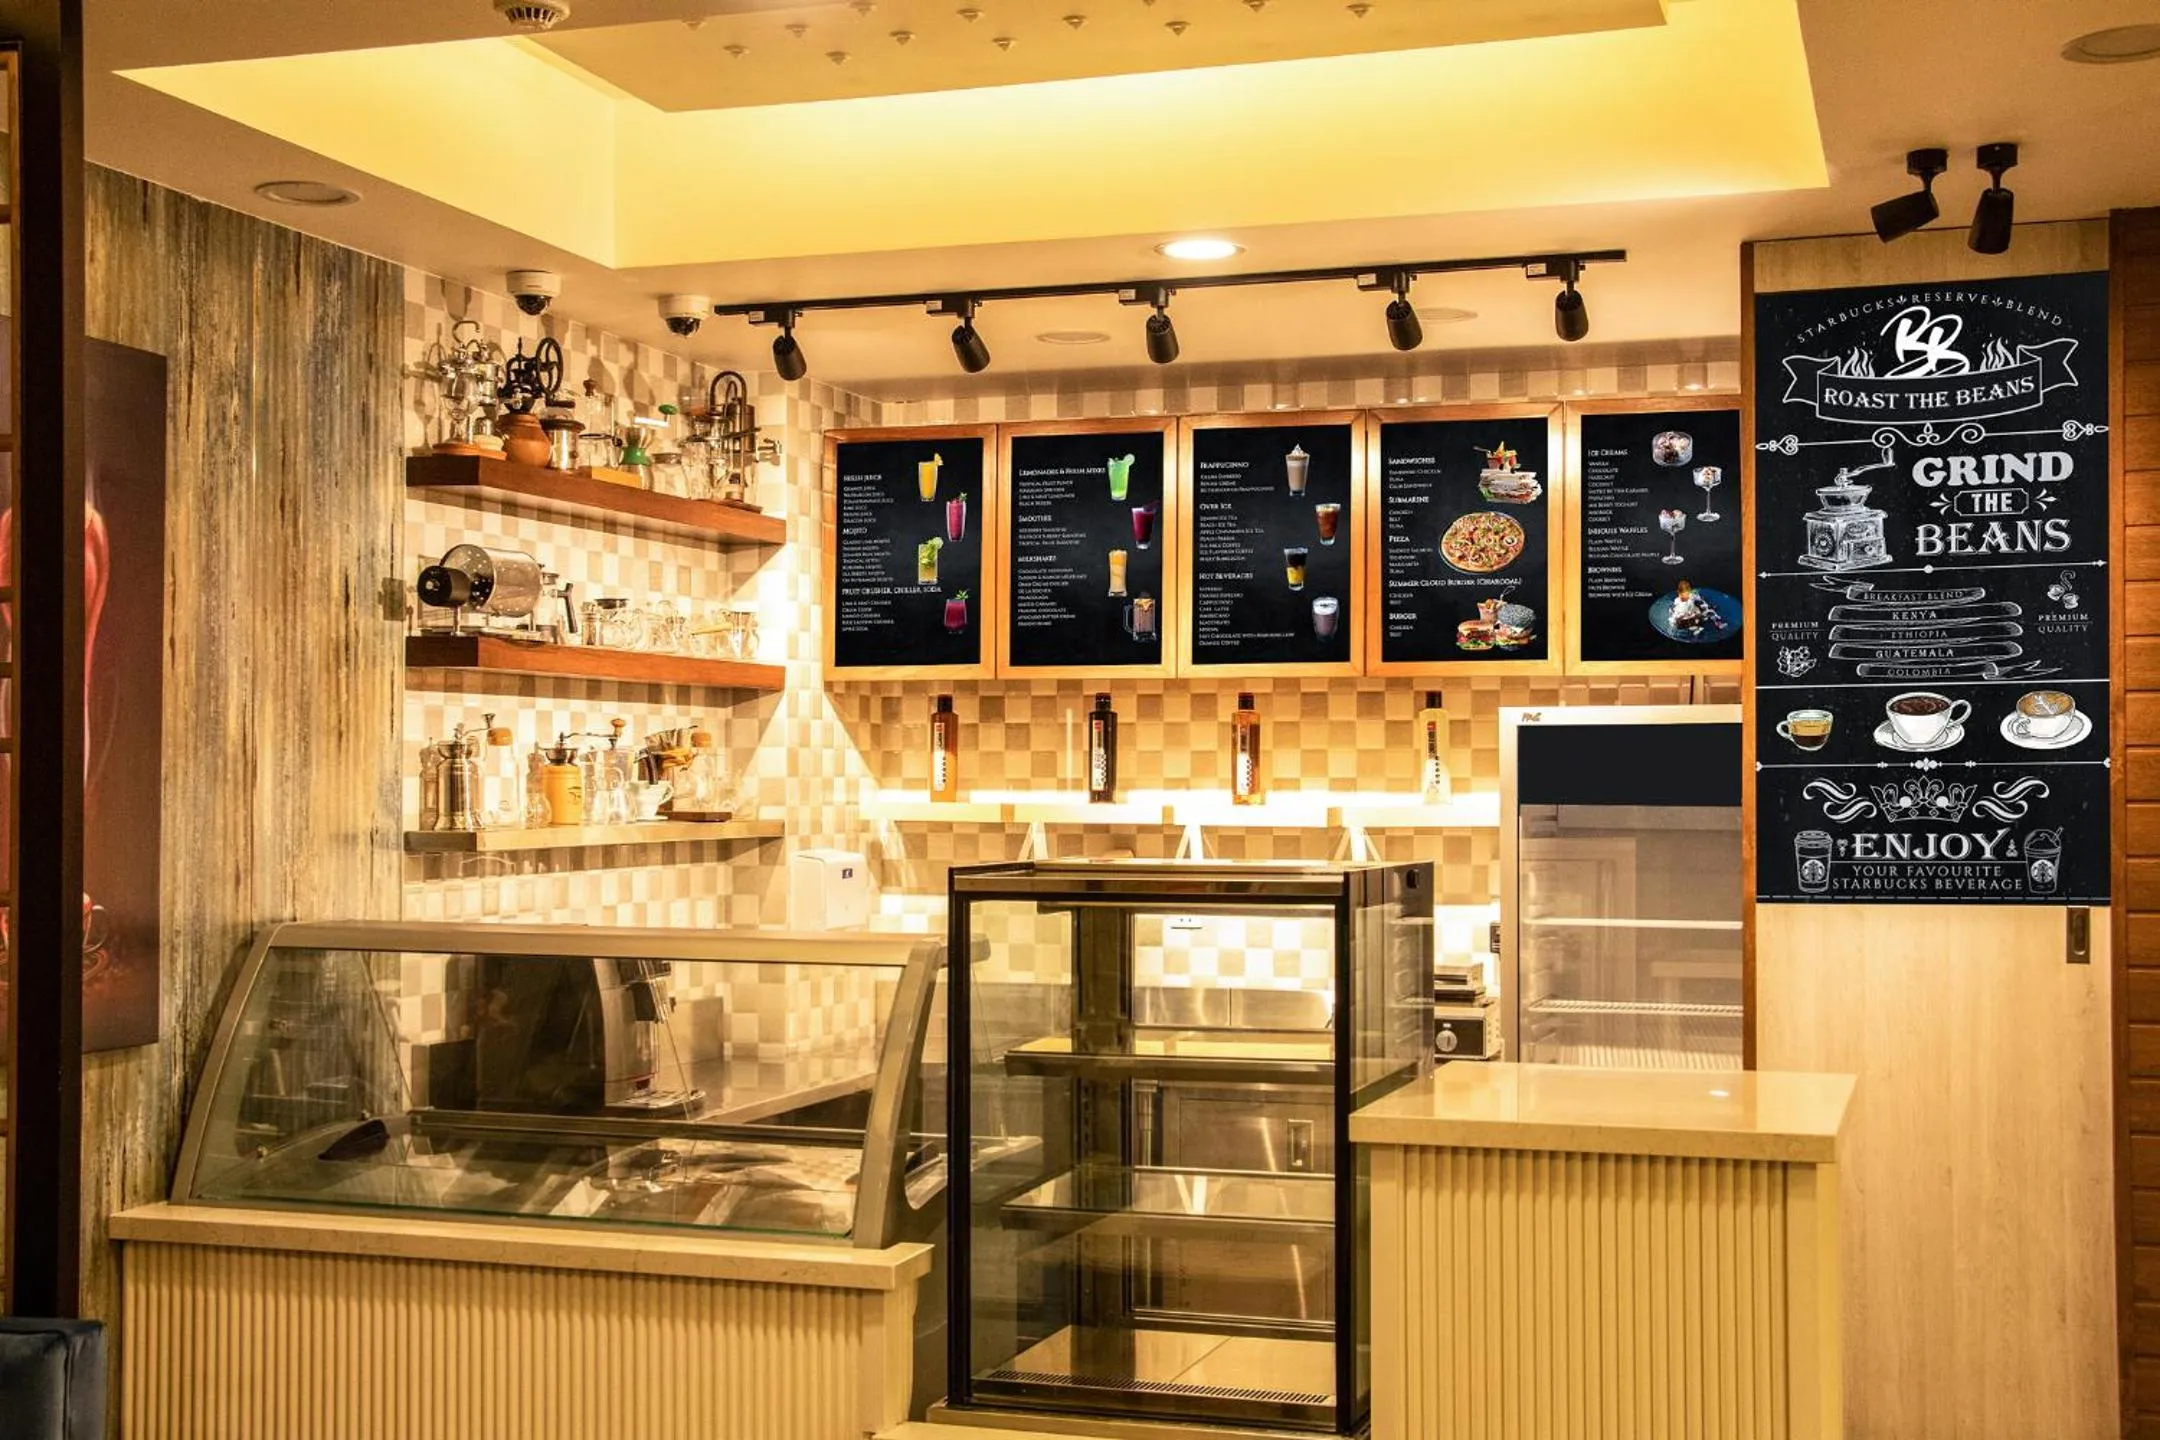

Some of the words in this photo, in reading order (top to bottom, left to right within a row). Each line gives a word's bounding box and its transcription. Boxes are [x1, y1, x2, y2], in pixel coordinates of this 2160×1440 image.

[1797, 298, 1895, 343] STARBUCKS
[1912, 292, 1988, 304] RESERVE
[2006, 300, 2063, 327] BLEND
[1824, 388, 1899, 409] ROAST
[1906, 392, 1949, 408] THE
[1956, 376, 2036, 406] BEANS
[1912, 452, 2074, 487] GRIND
[1972, 492, 2012, 512] THE
[1916, 519, 2071, 556] BEANS
[1863, 591, 1923, 601] BREAKFAST
[1928, 590, 1964, 599] BLEND
[1892, 610, 1938, 620] KENYA
[2038, 614, 2088, 622] PREMIUM
[2038, 624, 2088, 634] QUALITY
[1771, 631, 1820, 641] QUALITY
[1892, 630, 1948, 639] ETHIOPIA
[1875, 648, 1954, 658] GUATEMALA
[1888, 668, 1951, 677] COLOMBIA
[1852, 828, 2011, 860] ENJOY
[1852, 866, 1898, 876] YOUR
[1907, 866, 2002, 876] FAVOURITE
[1832, 878, 1927, 890] STARBUCKS
[1935, 878, 2022, 890] BEVERAGE
